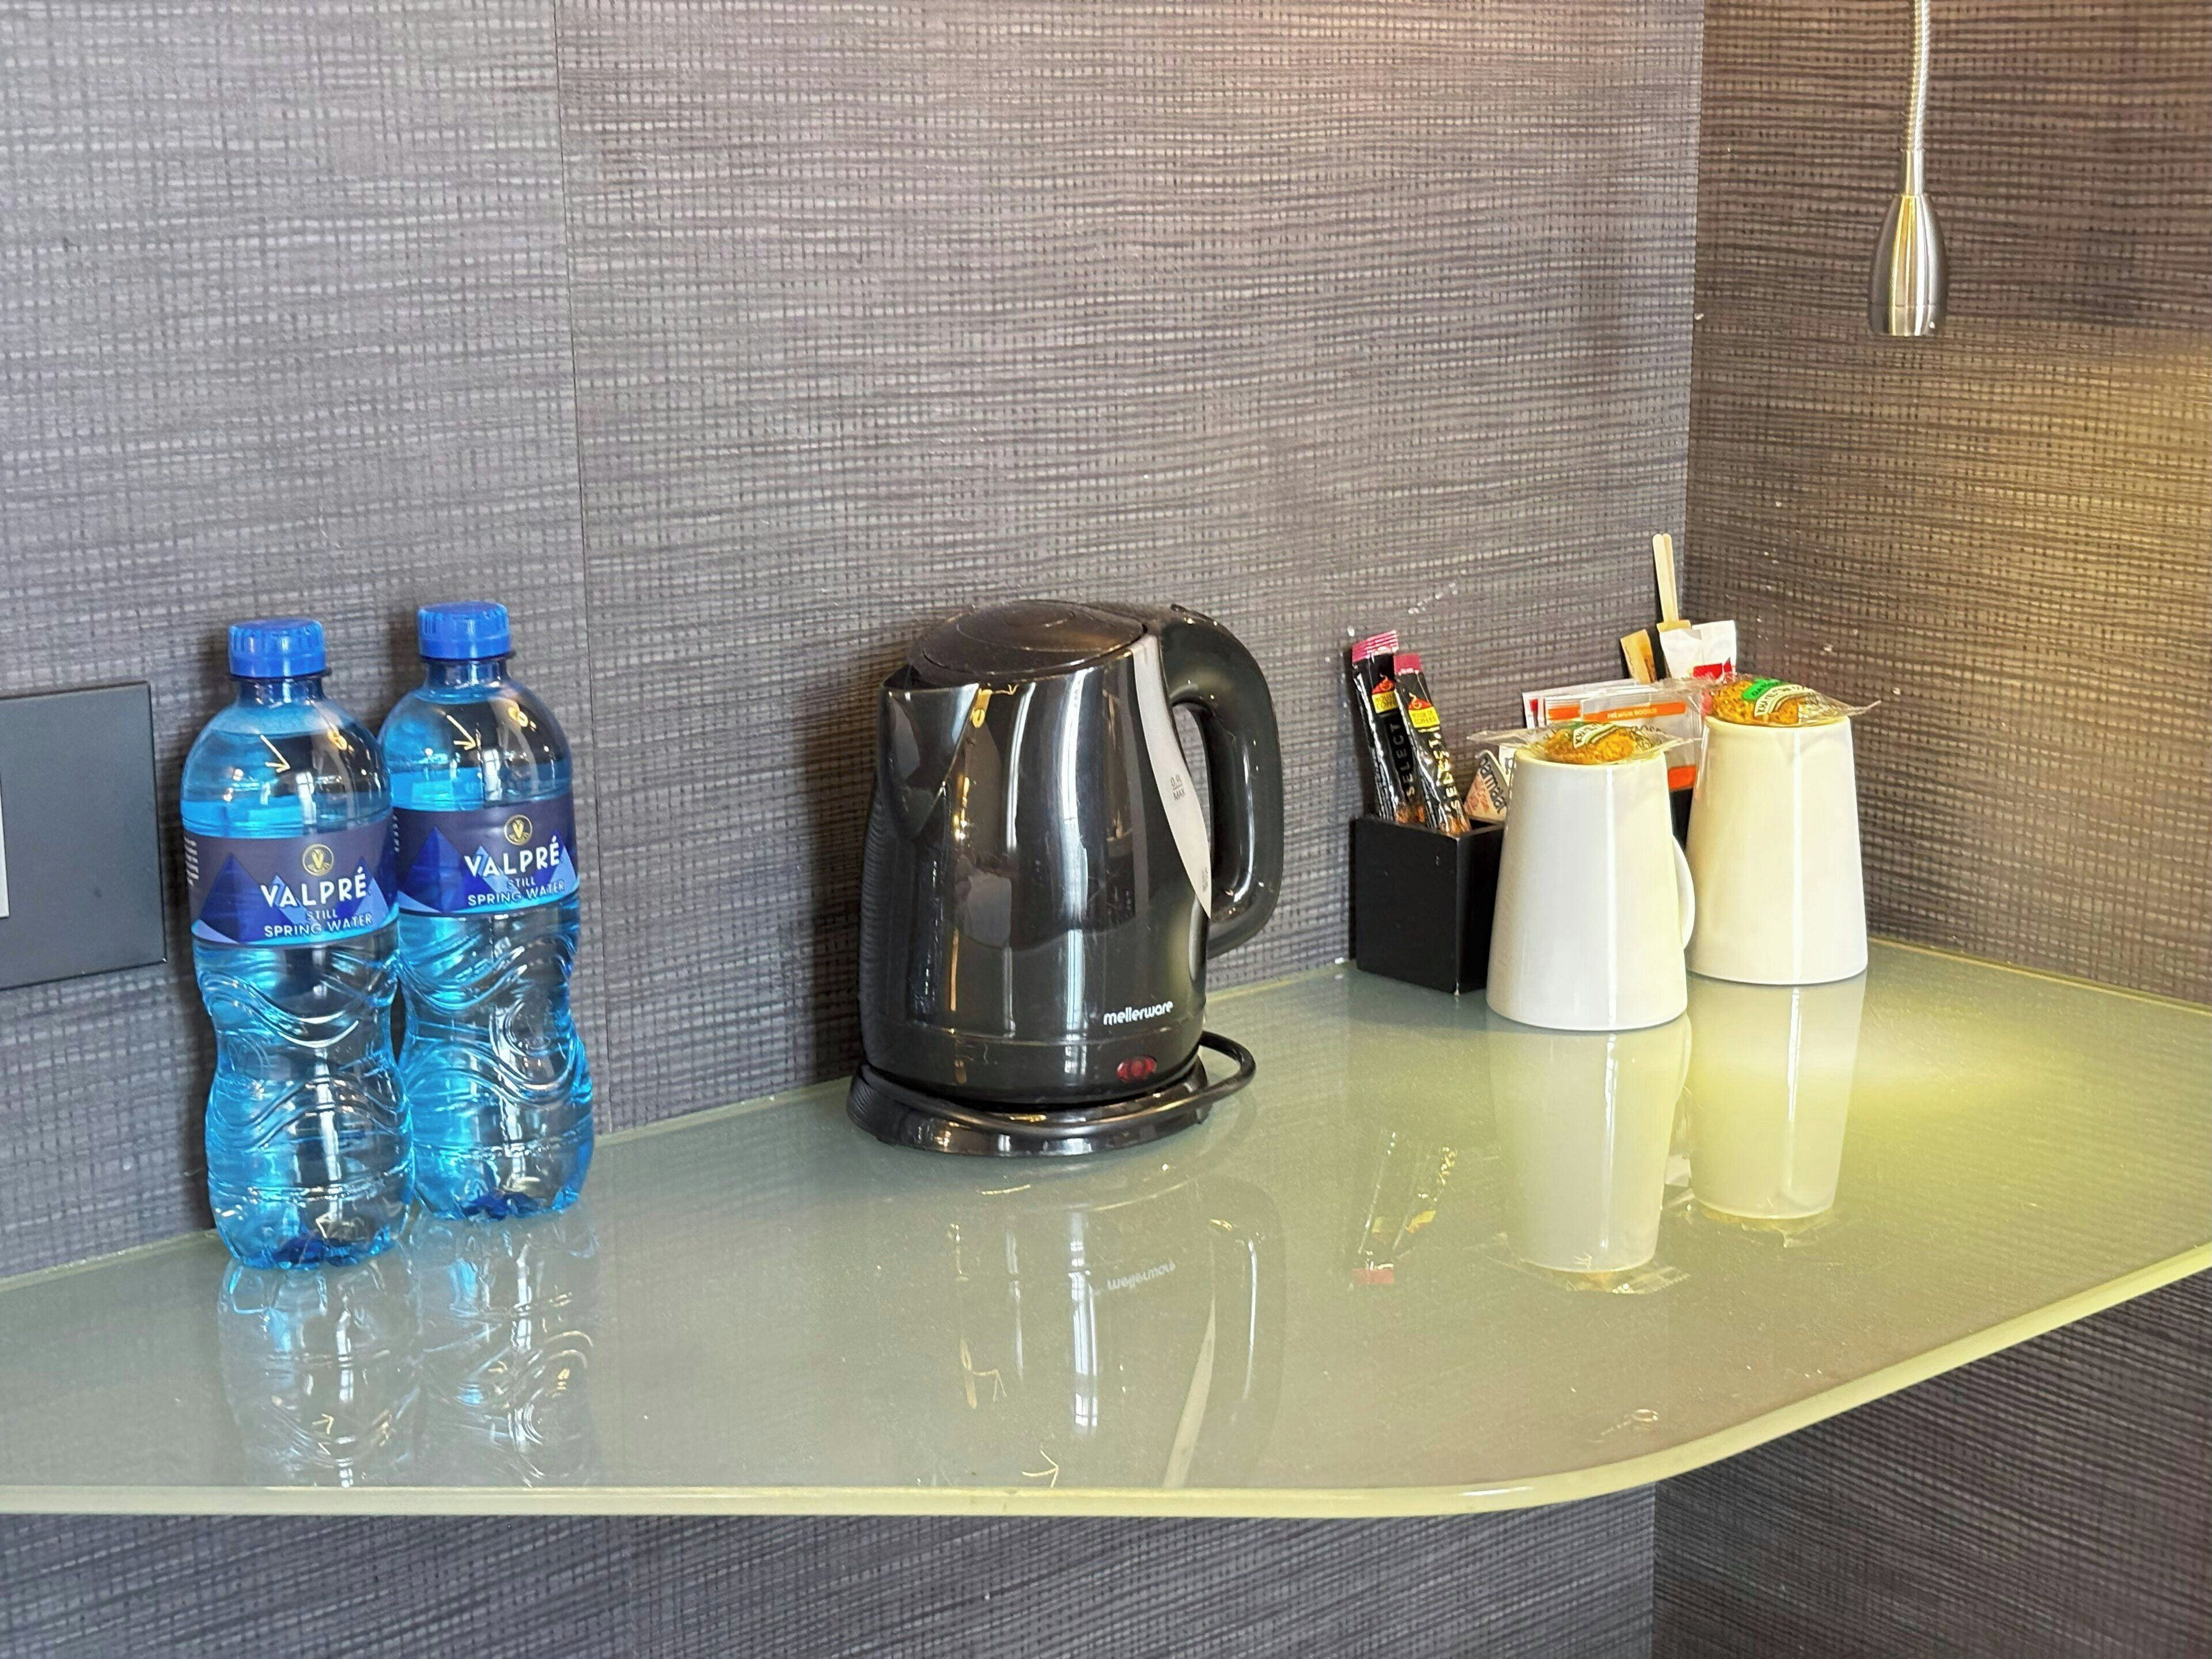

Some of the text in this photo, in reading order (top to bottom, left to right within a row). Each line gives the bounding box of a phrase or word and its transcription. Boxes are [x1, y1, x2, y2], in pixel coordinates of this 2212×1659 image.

[1389, 723, 1415, 797] SELECT
[464, 835, 560, 877] VALPRÉ
[260, 866, 367, 908] VALPRÉ
[467, 879, 565, 907] SPRING WATER
[507, 876, 536, 889] STILL
[264, 913, 373, 938] SPRING WATER
[306, 908, 339, 921] STILL
[1103, 1001, 1173, 1025] mellerware
